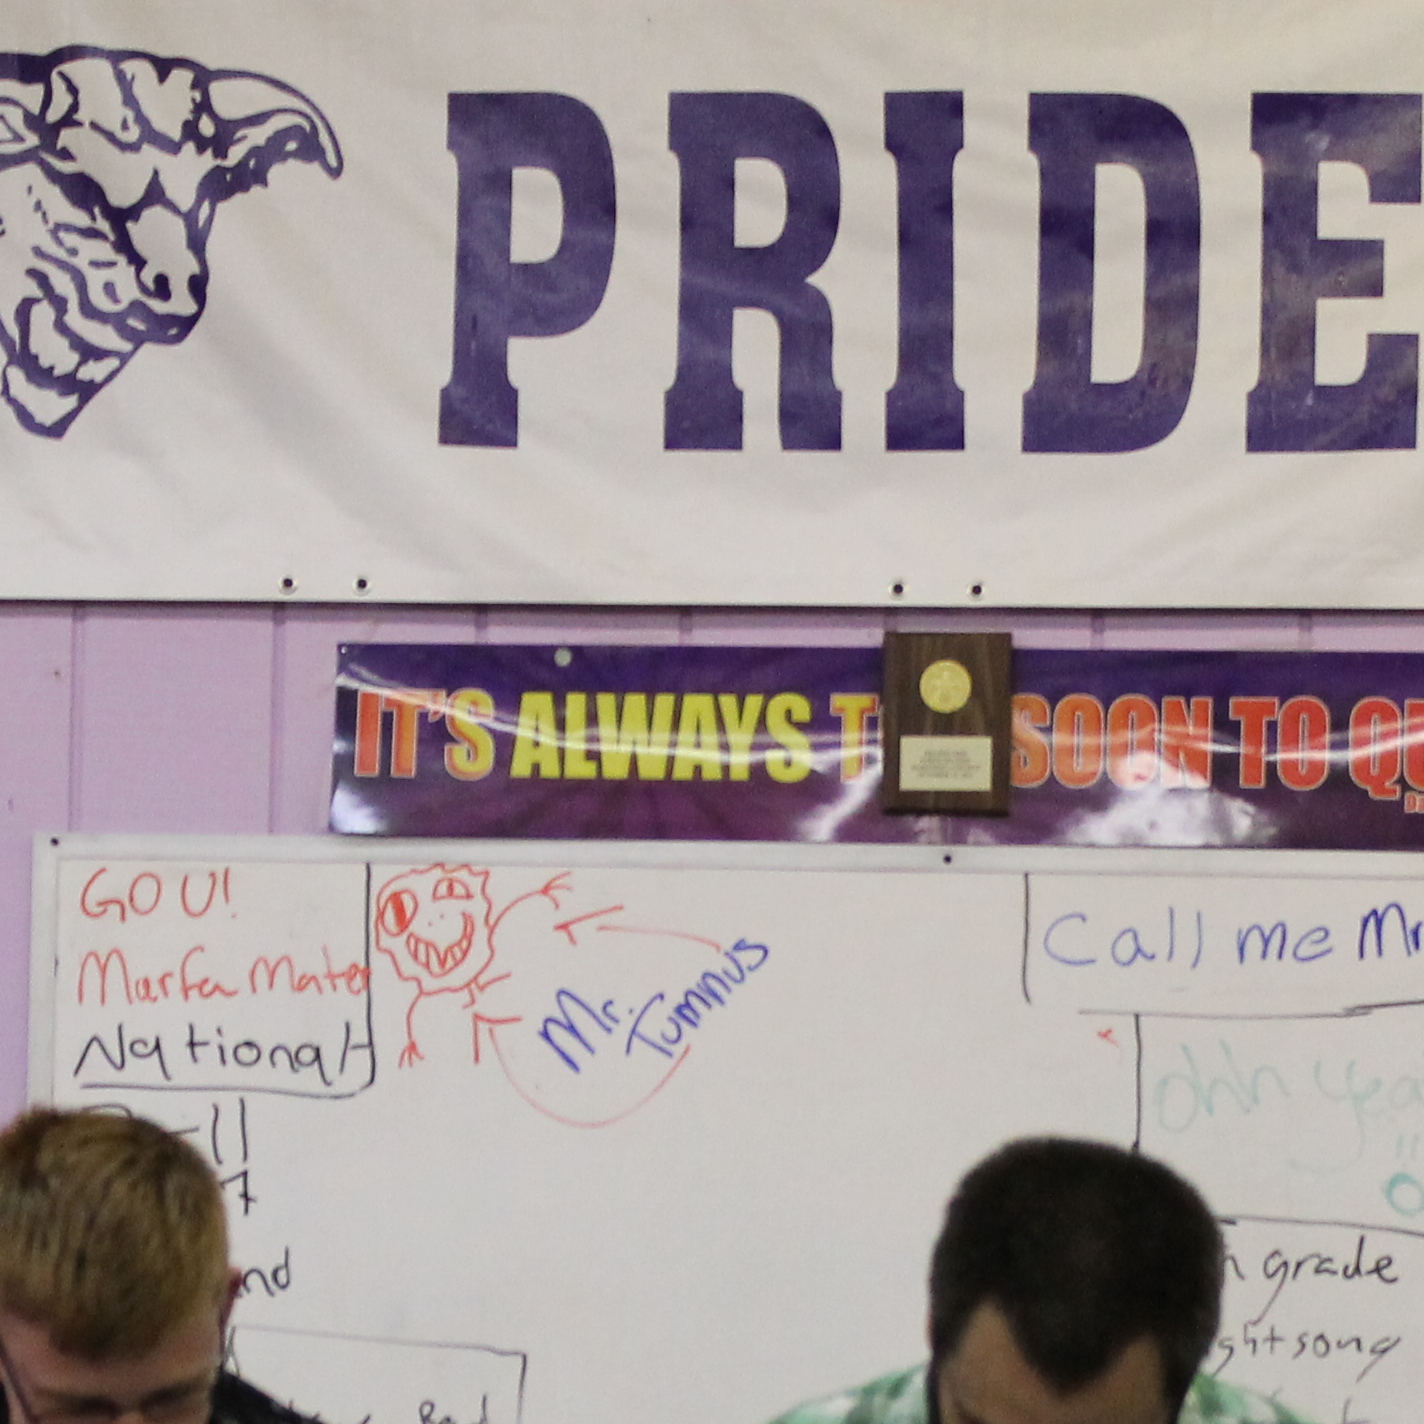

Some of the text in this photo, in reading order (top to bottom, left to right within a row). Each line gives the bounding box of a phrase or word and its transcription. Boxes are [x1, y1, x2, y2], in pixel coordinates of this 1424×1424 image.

[438, 91, 1423, 454] PRIDE
[354, 687, 496, 780] IT'S
[510, 692, 812, 783] ALWAYS
[1012, 693, 1214, 791] SOON
[1229, 695, 1331, 791] TO
[78, 945, 239, 1006] Marfa
[1044, 907, 1204, 970] Call
[1237, 921, 1334, 963] me
[538, 988, 635, 1074] Mr.
